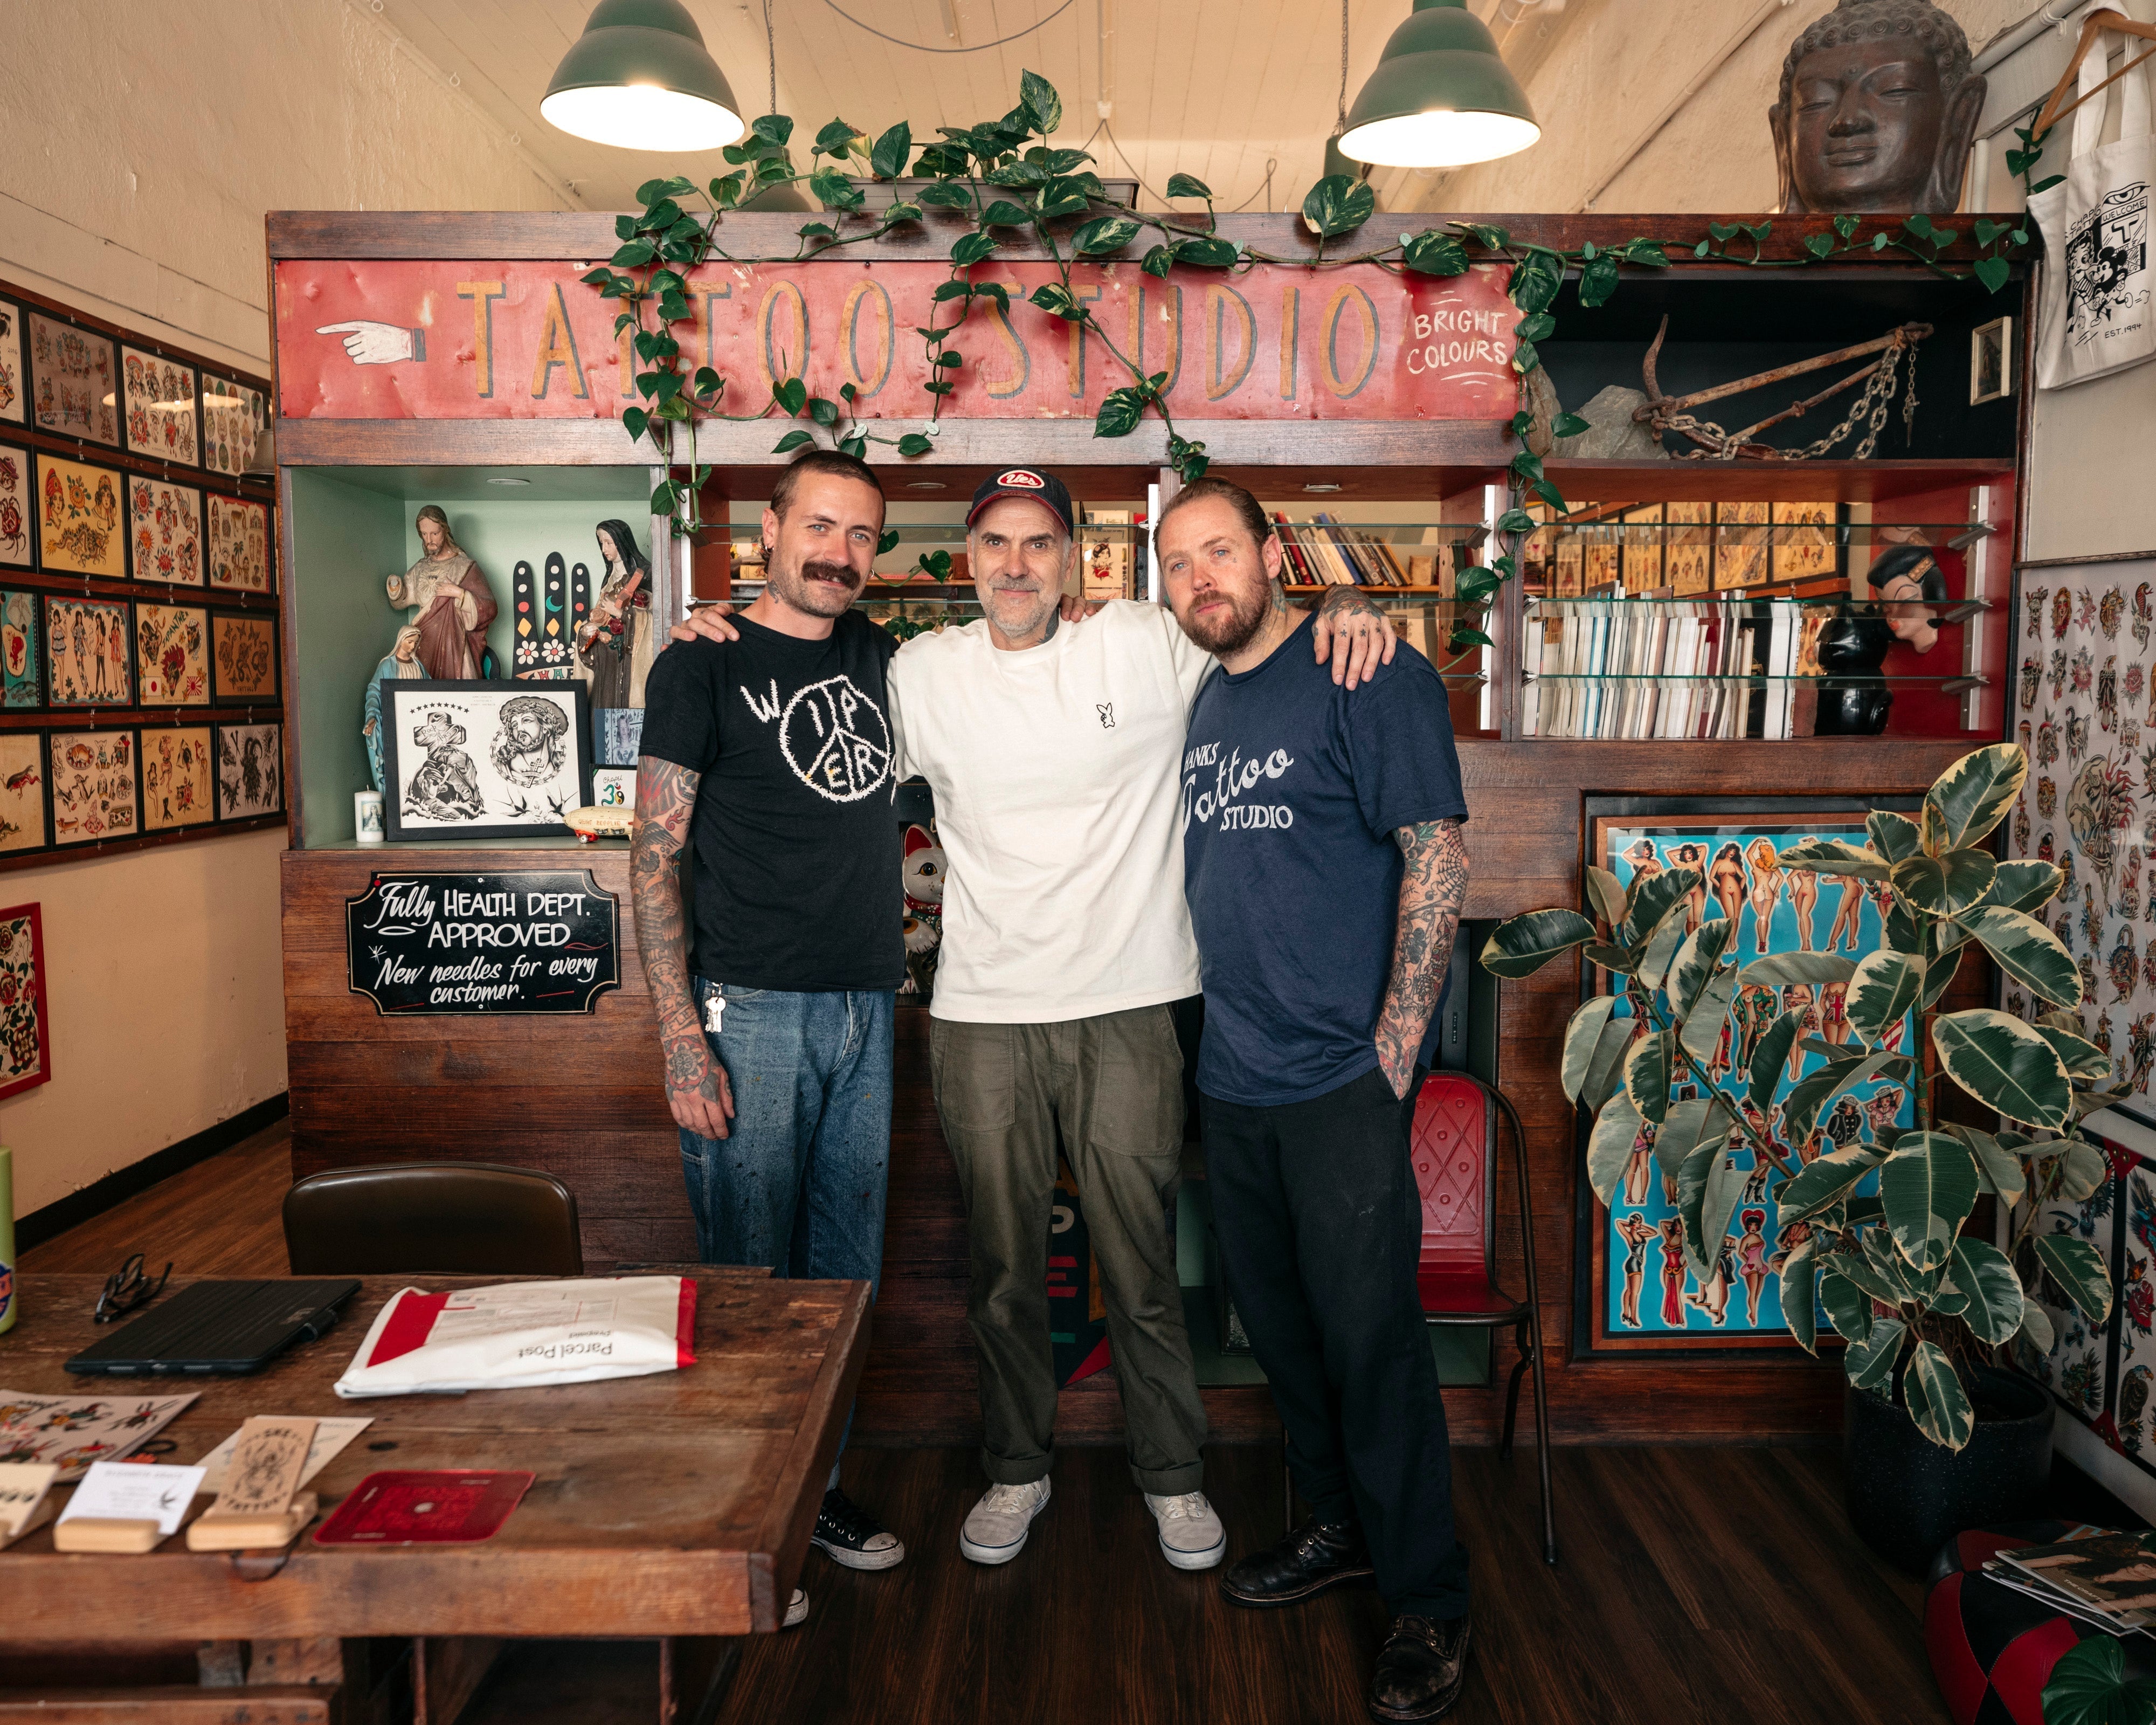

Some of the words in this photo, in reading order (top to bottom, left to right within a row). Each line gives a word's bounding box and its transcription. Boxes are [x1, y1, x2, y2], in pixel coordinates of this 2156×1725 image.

[2103, 199, 2145, 222] WELCOME
[1414, 309, 1509, 339] BRIGHT
[457, 279, 895, 400] TATTOO
[984, 282, 1380, 401] STUDIO
[1406, 340, 1508, 374] COLOURS
[1183, 746, 1294, 836] Tattoo
[1220, 805, 1294, 832] STUDIO
[363, 881, 436, 929] Fully
[444, 889, 516, 916] HEALTH
[528, 893, 591, 916] DEPT.
[428, 921, 570, 948] APPROVED
[374, 954, 425, 990] New
[429, 955, 502, 983] needles
[509, 954, 542, 982] for
[549, 956, 598, 982] every
[430, 982, 525, 1004] customer.
[518, 1344, 556, 1359] Post
[561, 1342, 613, 1358] Parcel
